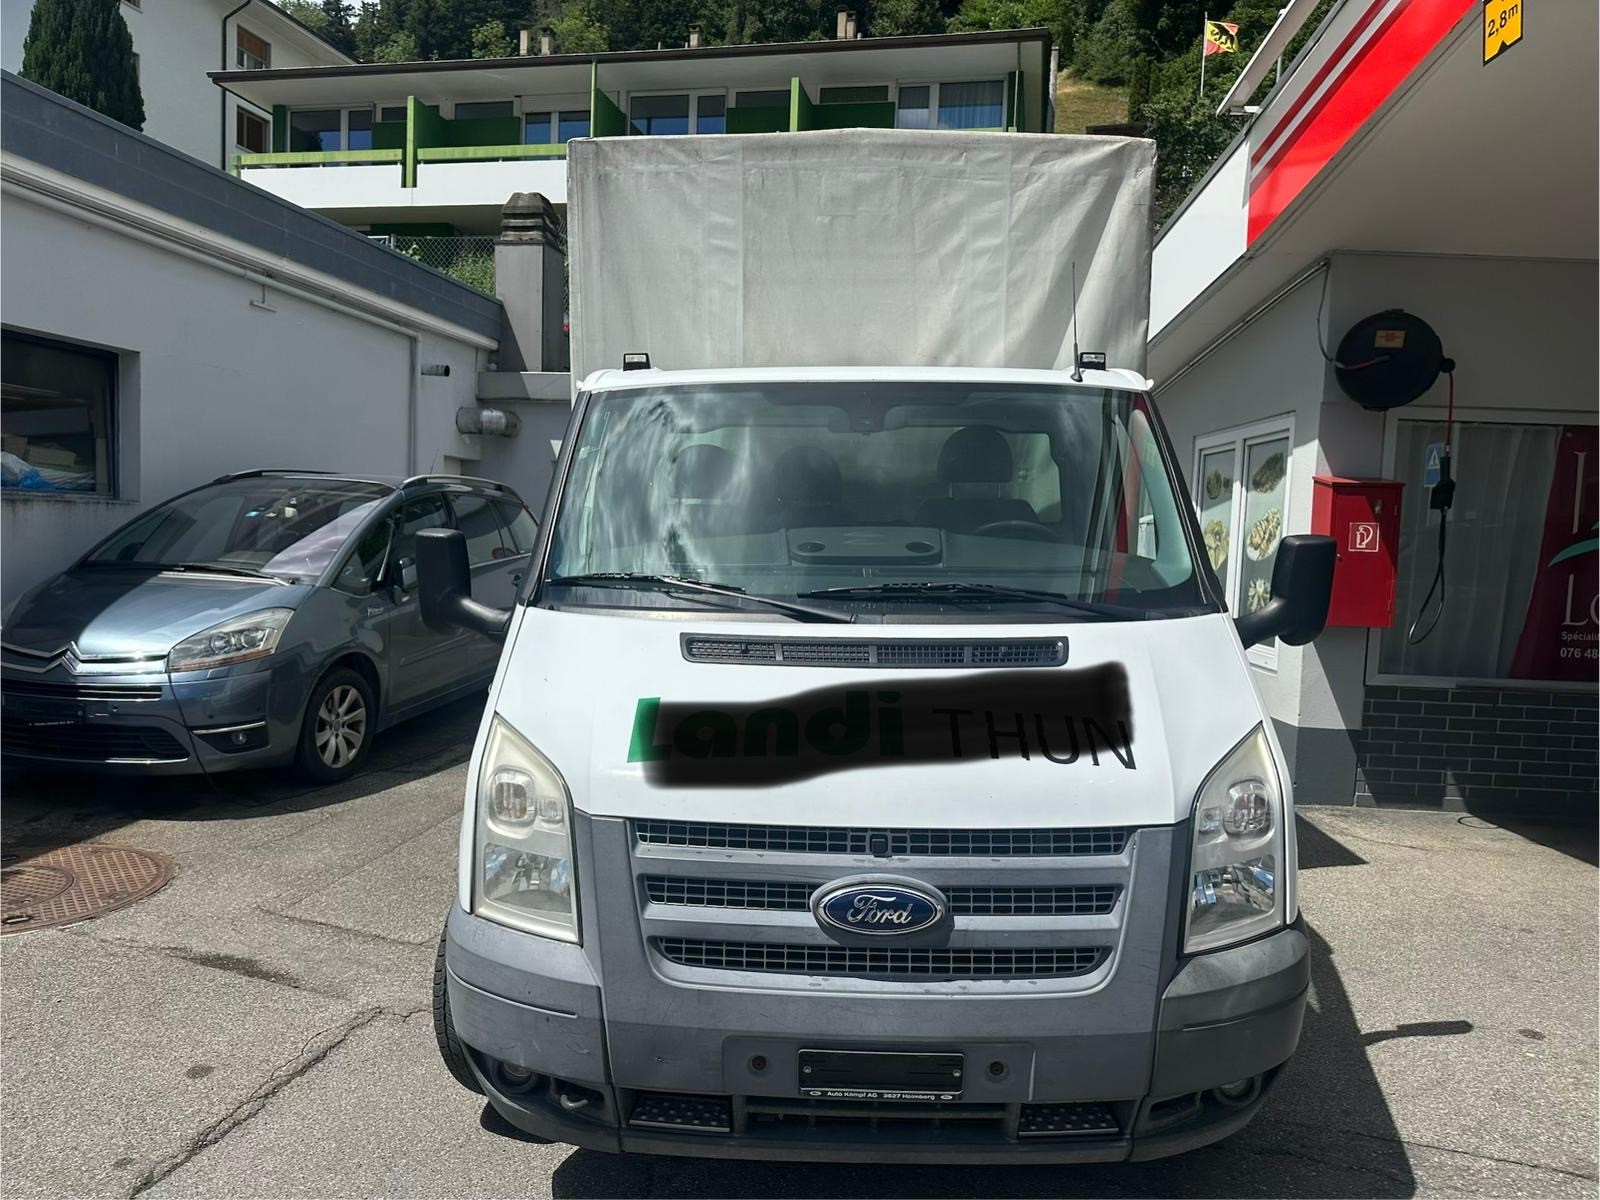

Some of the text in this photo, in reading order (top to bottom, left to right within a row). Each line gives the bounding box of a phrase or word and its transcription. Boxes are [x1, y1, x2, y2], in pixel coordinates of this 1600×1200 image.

[1487, 4, 1518, 38] 2,8m
[1560, 647, 1581, 659] 076
[627, 691, 1137, 770] Landi THUN
[847, 894, 913, 924] Ford
